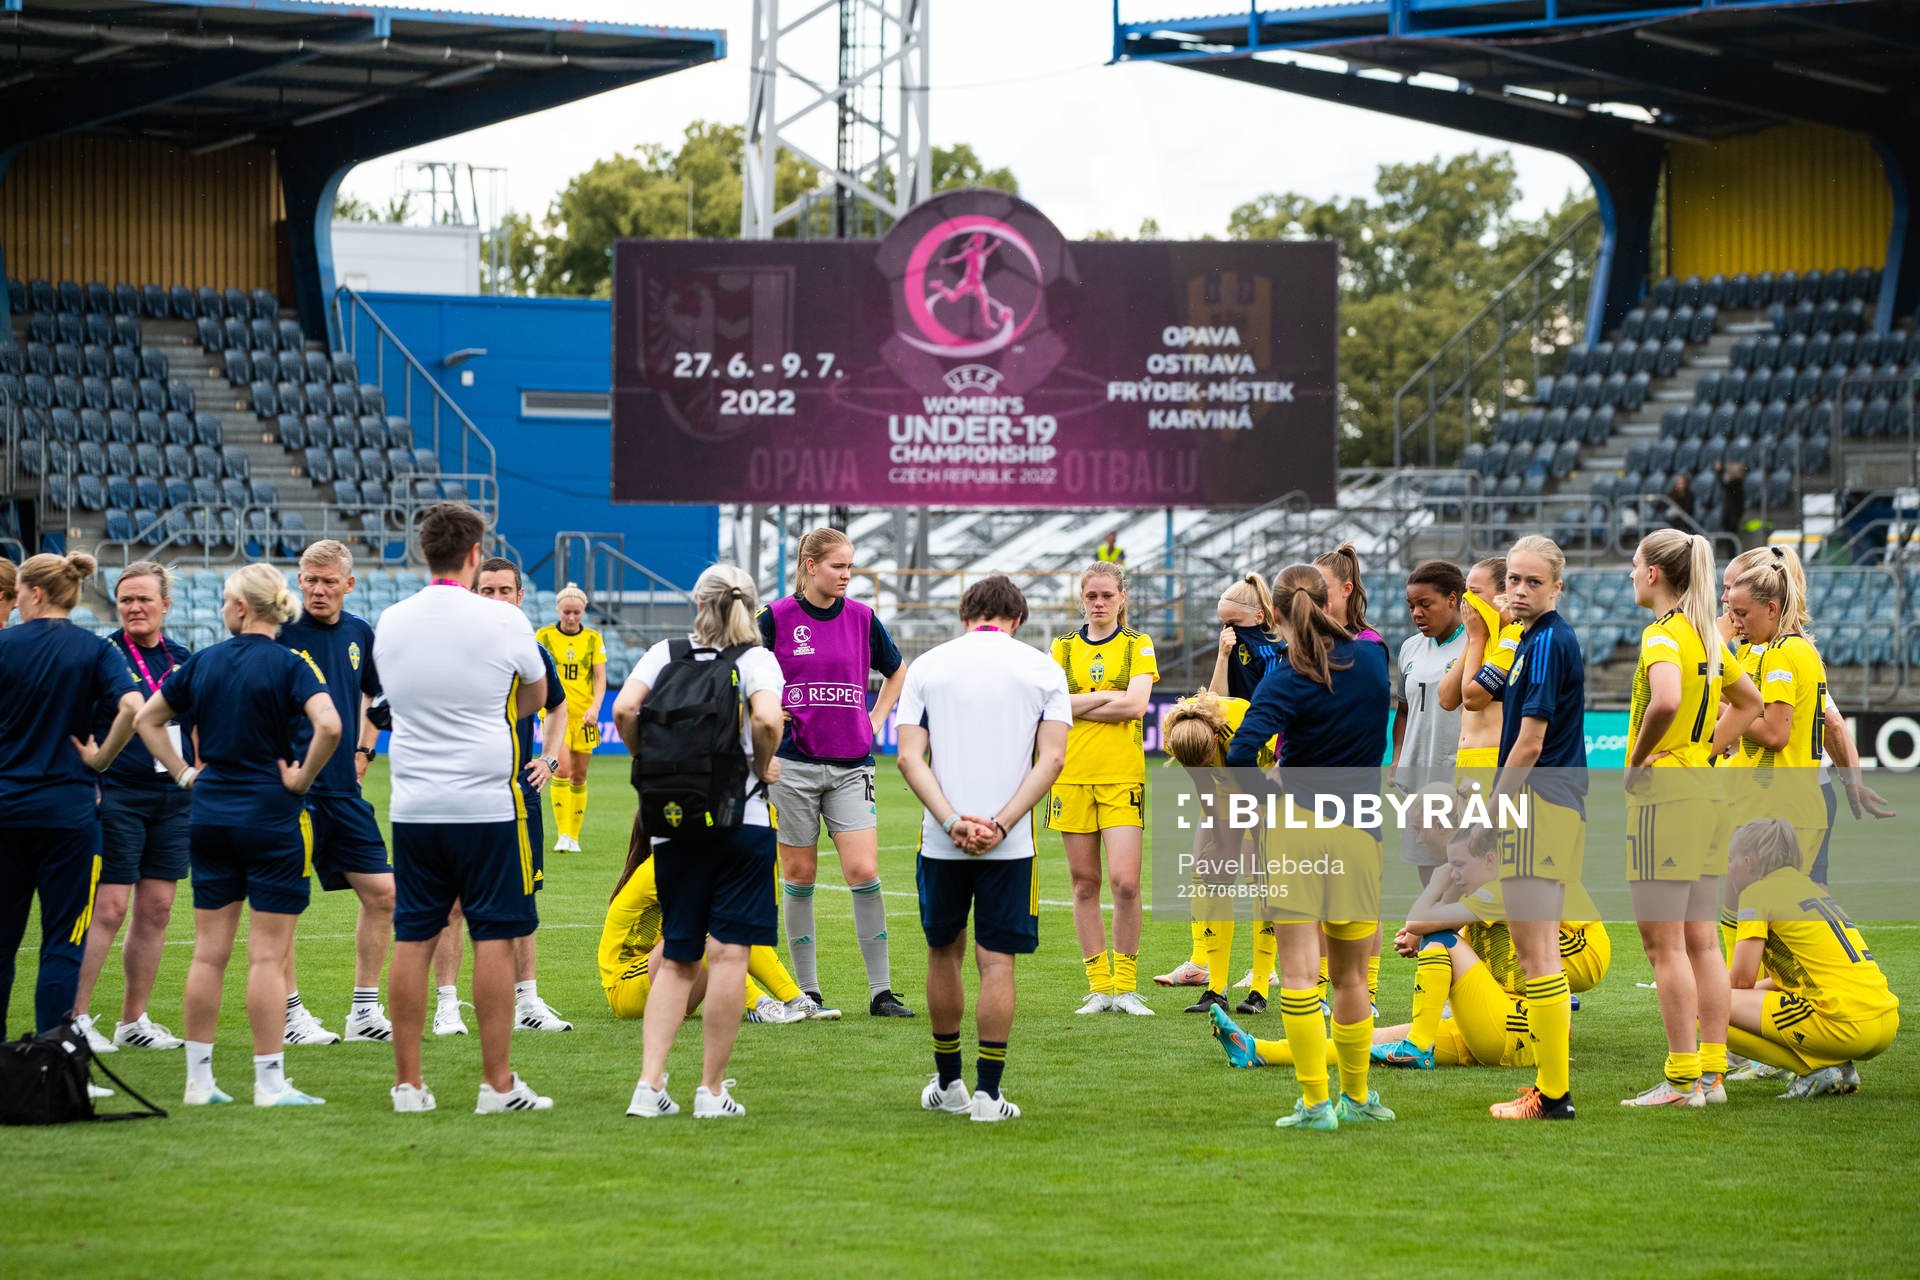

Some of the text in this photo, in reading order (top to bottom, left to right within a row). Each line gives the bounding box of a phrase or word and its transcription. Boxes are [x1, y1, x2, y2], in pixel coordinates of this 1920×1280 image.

[1162, 326, 1241, 347] OPAVA
[673, 352, 720, 378] 27.
[727, 352, 754, 378] 6.
[781, 352, 809, 378] 9.
[816, 352, 844, 378] 7.
[1147, 353, 1256, 374] OSTRAVA
[948, 367, 1000, 391] UEFA
[1107, 379, 1295, 403] FRÝDEK-MÍSTEK
[720, 390, 796, 416] 2022
[922, 396, 1025, 416] WOMEN'S
[888, 414, 1058, 445] UNDER-19
[1149, 408, 1253, 430] KARVINÁ
[889, 444, 1057, 465] CHAMPIONSHIP
[748, 448, 861, 492] OPAVA
[888, 467, 1058, 485] CZECH REPUBLIC 2022
[1047, 448, 1200, 493] OTBALU
[563, 663, 578, 680] 18
[808, 687, 863, 704] RESPECT
[1418, 682, 1426, 712] 1
[1129, 790, 1142, 820] 4
